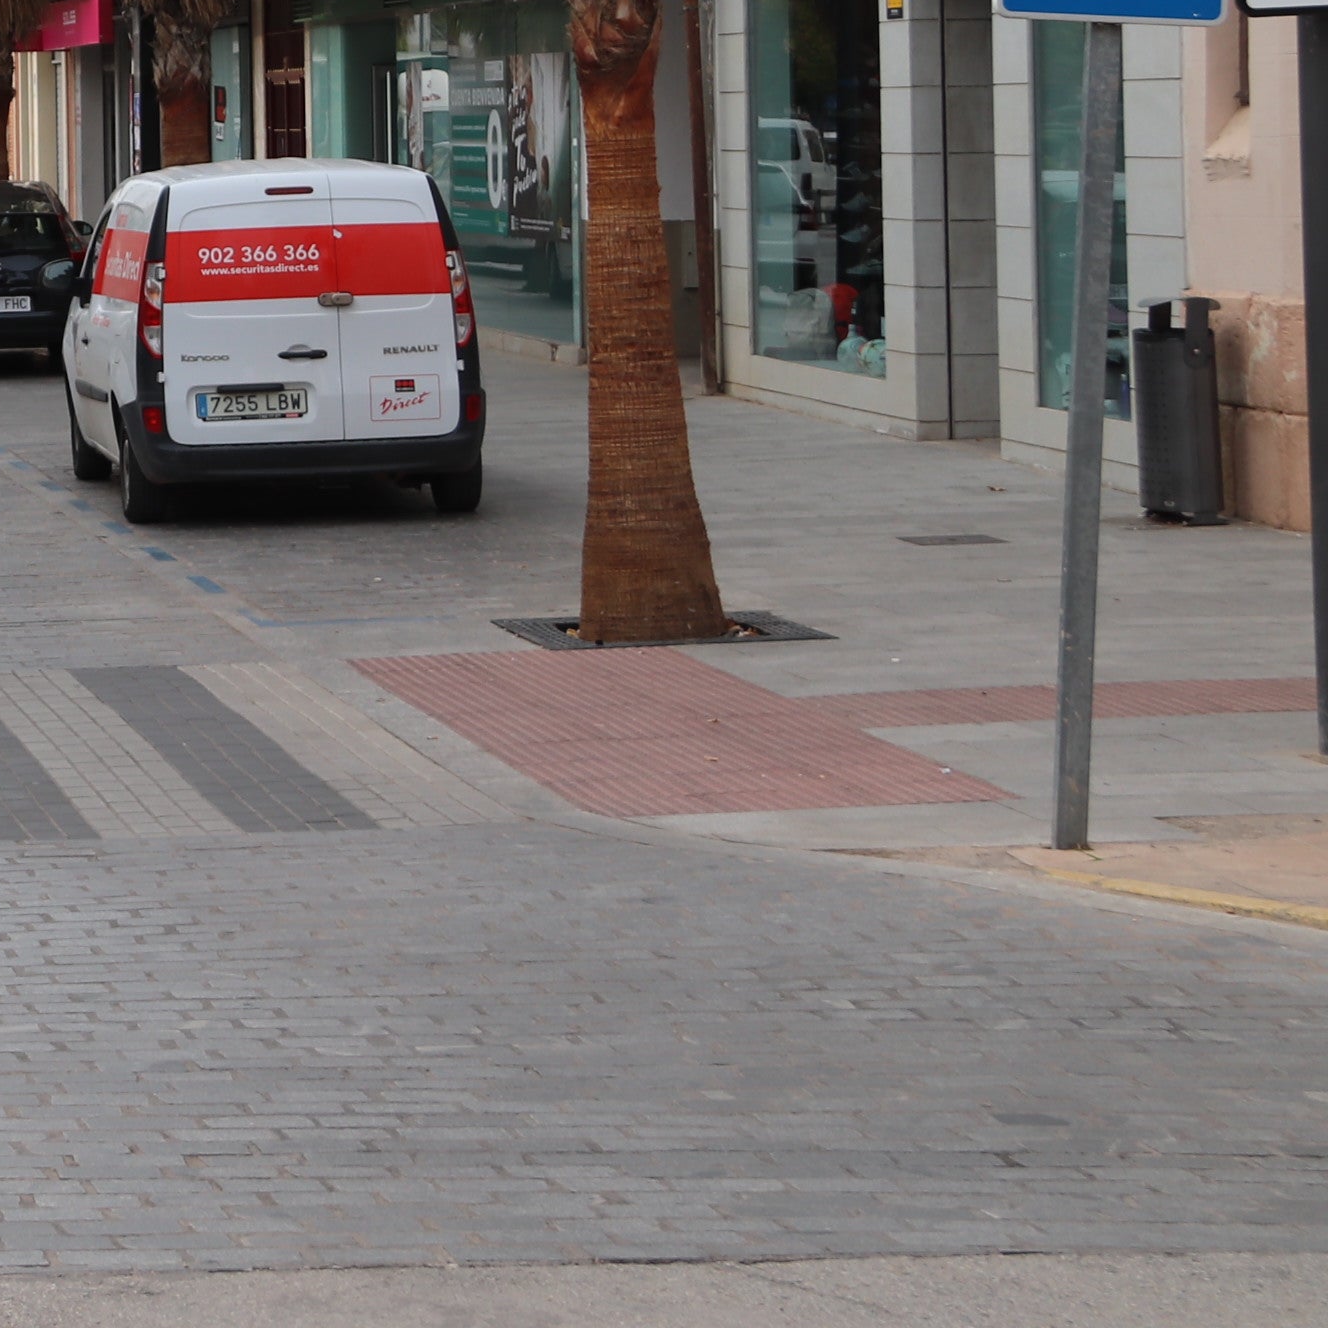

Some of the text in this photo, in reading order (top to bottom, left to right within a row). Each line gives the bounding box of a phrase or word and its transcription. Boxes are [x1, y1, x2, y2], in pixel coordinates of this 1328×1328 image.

[198, 243, 320, 264] 902 366 366
[200, 263, 319, 276] www.securitasdirect.es
[4, 298, 27, 310] FHC
[383, 343, 440, 355] RENAULT
[210, 394, 301, 415] 7255 LBW
[378, 391, 432, 415] Direct
